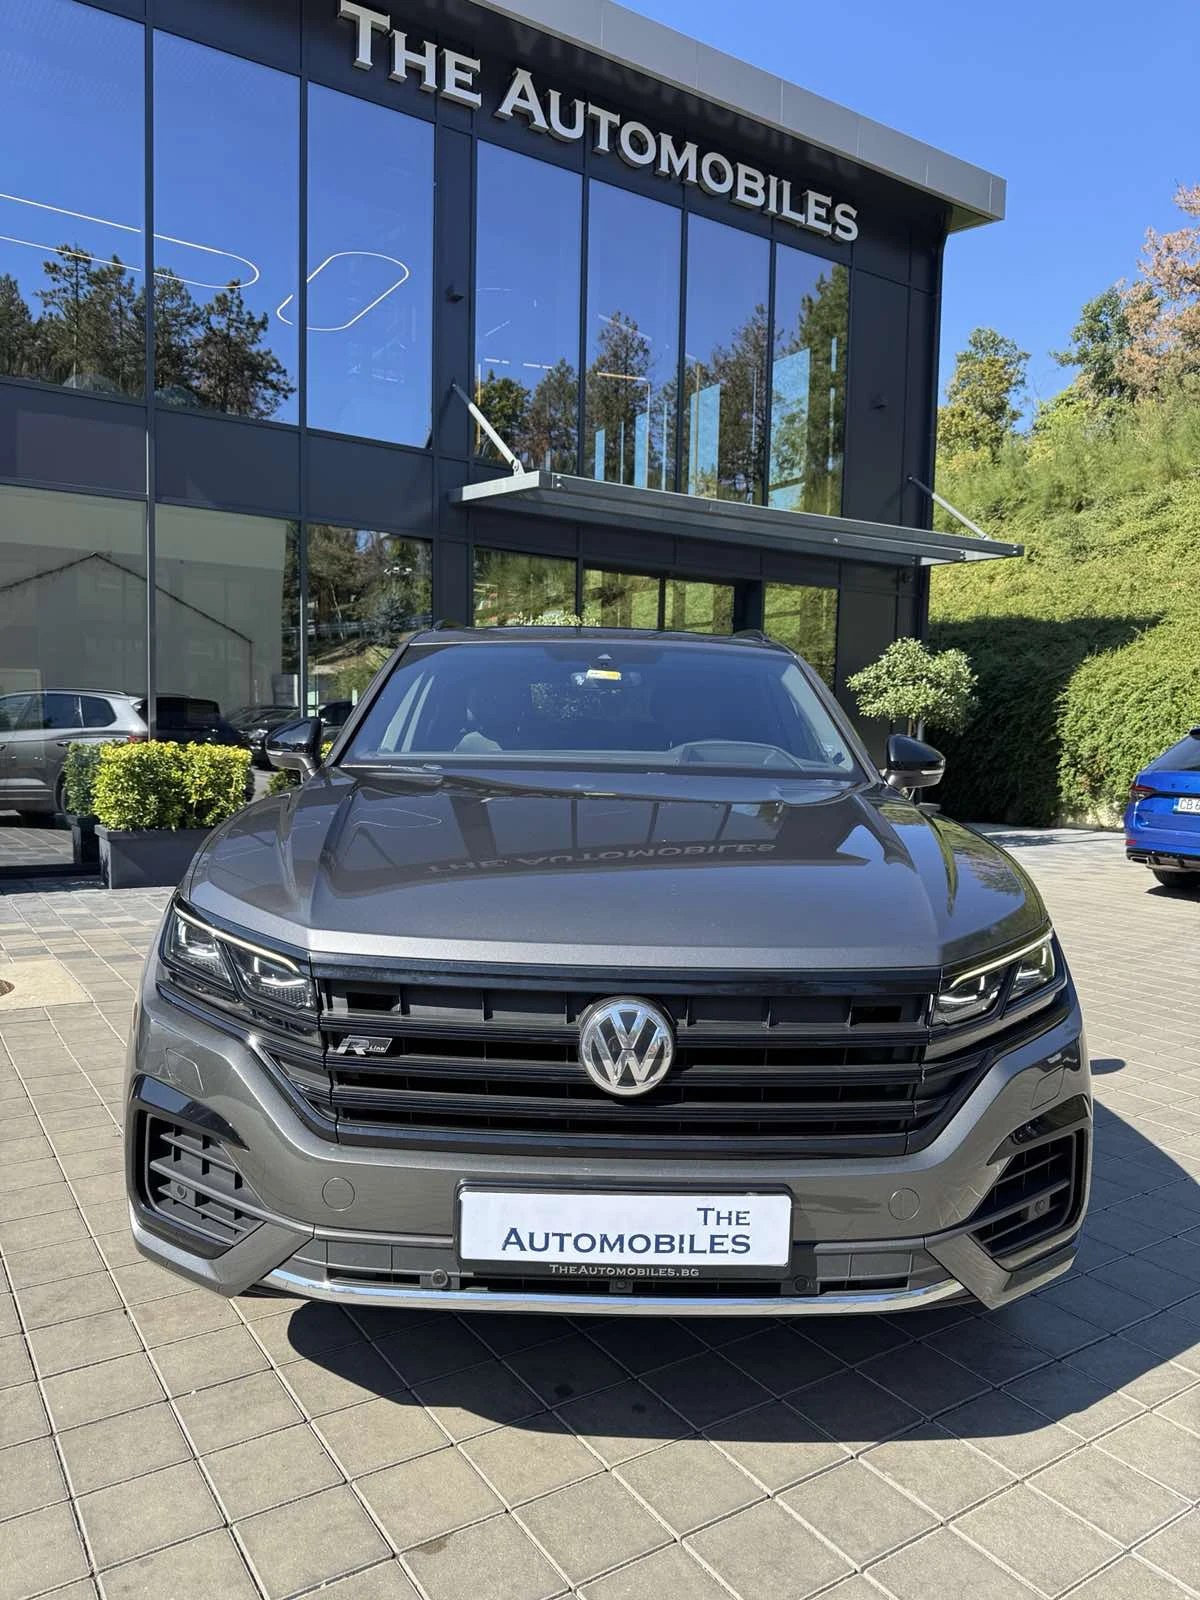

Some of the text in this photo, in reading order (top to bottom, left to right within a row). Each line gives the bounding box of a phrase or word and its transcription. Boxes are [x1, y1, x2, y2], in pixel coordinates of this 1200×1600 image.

[339, 0, 481, 110] THE
[495, 67, 859, 243] AUTOMOBILES
[697, 1207, 750, 1226] THE
[502, 1227, 750, 1254] AUTOMOBILES
